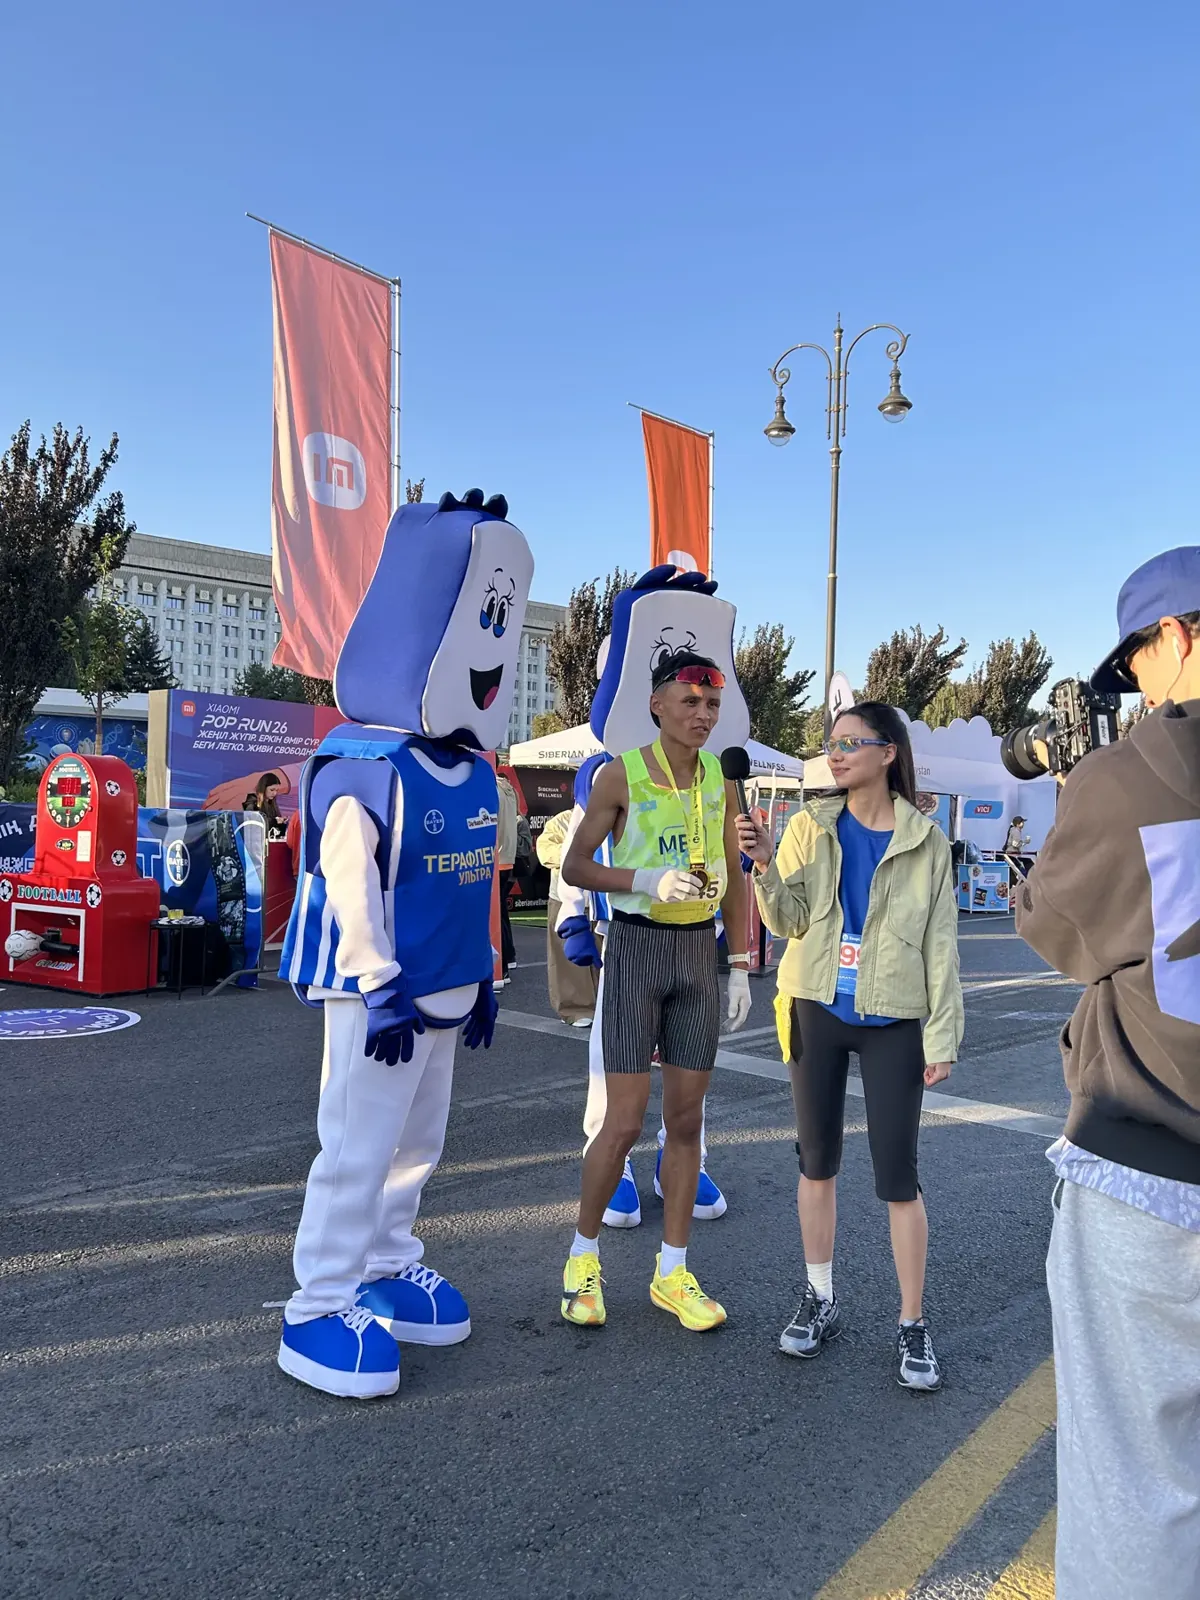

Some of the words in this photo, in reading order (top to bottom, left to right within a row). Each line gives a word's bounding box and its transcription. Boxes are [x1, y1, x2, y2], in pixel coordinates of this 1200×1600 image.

[206, 703, 240, 714] XIAOMI
[201, 715, 237, 729] POP
[237, 718, 273, 733] RUN
[272, 721, 288, 734] 26
[197, 730, 229, 740] ЖЕҢІЛ
[258, 735, 282, 743] ЕРКІН
[283, 736, 304, 744] ӨМІР
[193, 741, 216, 749] БЕГИ
[216, 742, 245, 752] ЛЕГКО.
[246, 744, 274, 753] ЖИВИ
[538, 750, 585, 759] SIBERIAN
[458, 867, 492, 886] УЛЬТРА
[17, 885, 82, 904] FOOTBALL
[708, 904, 714, 912] A
